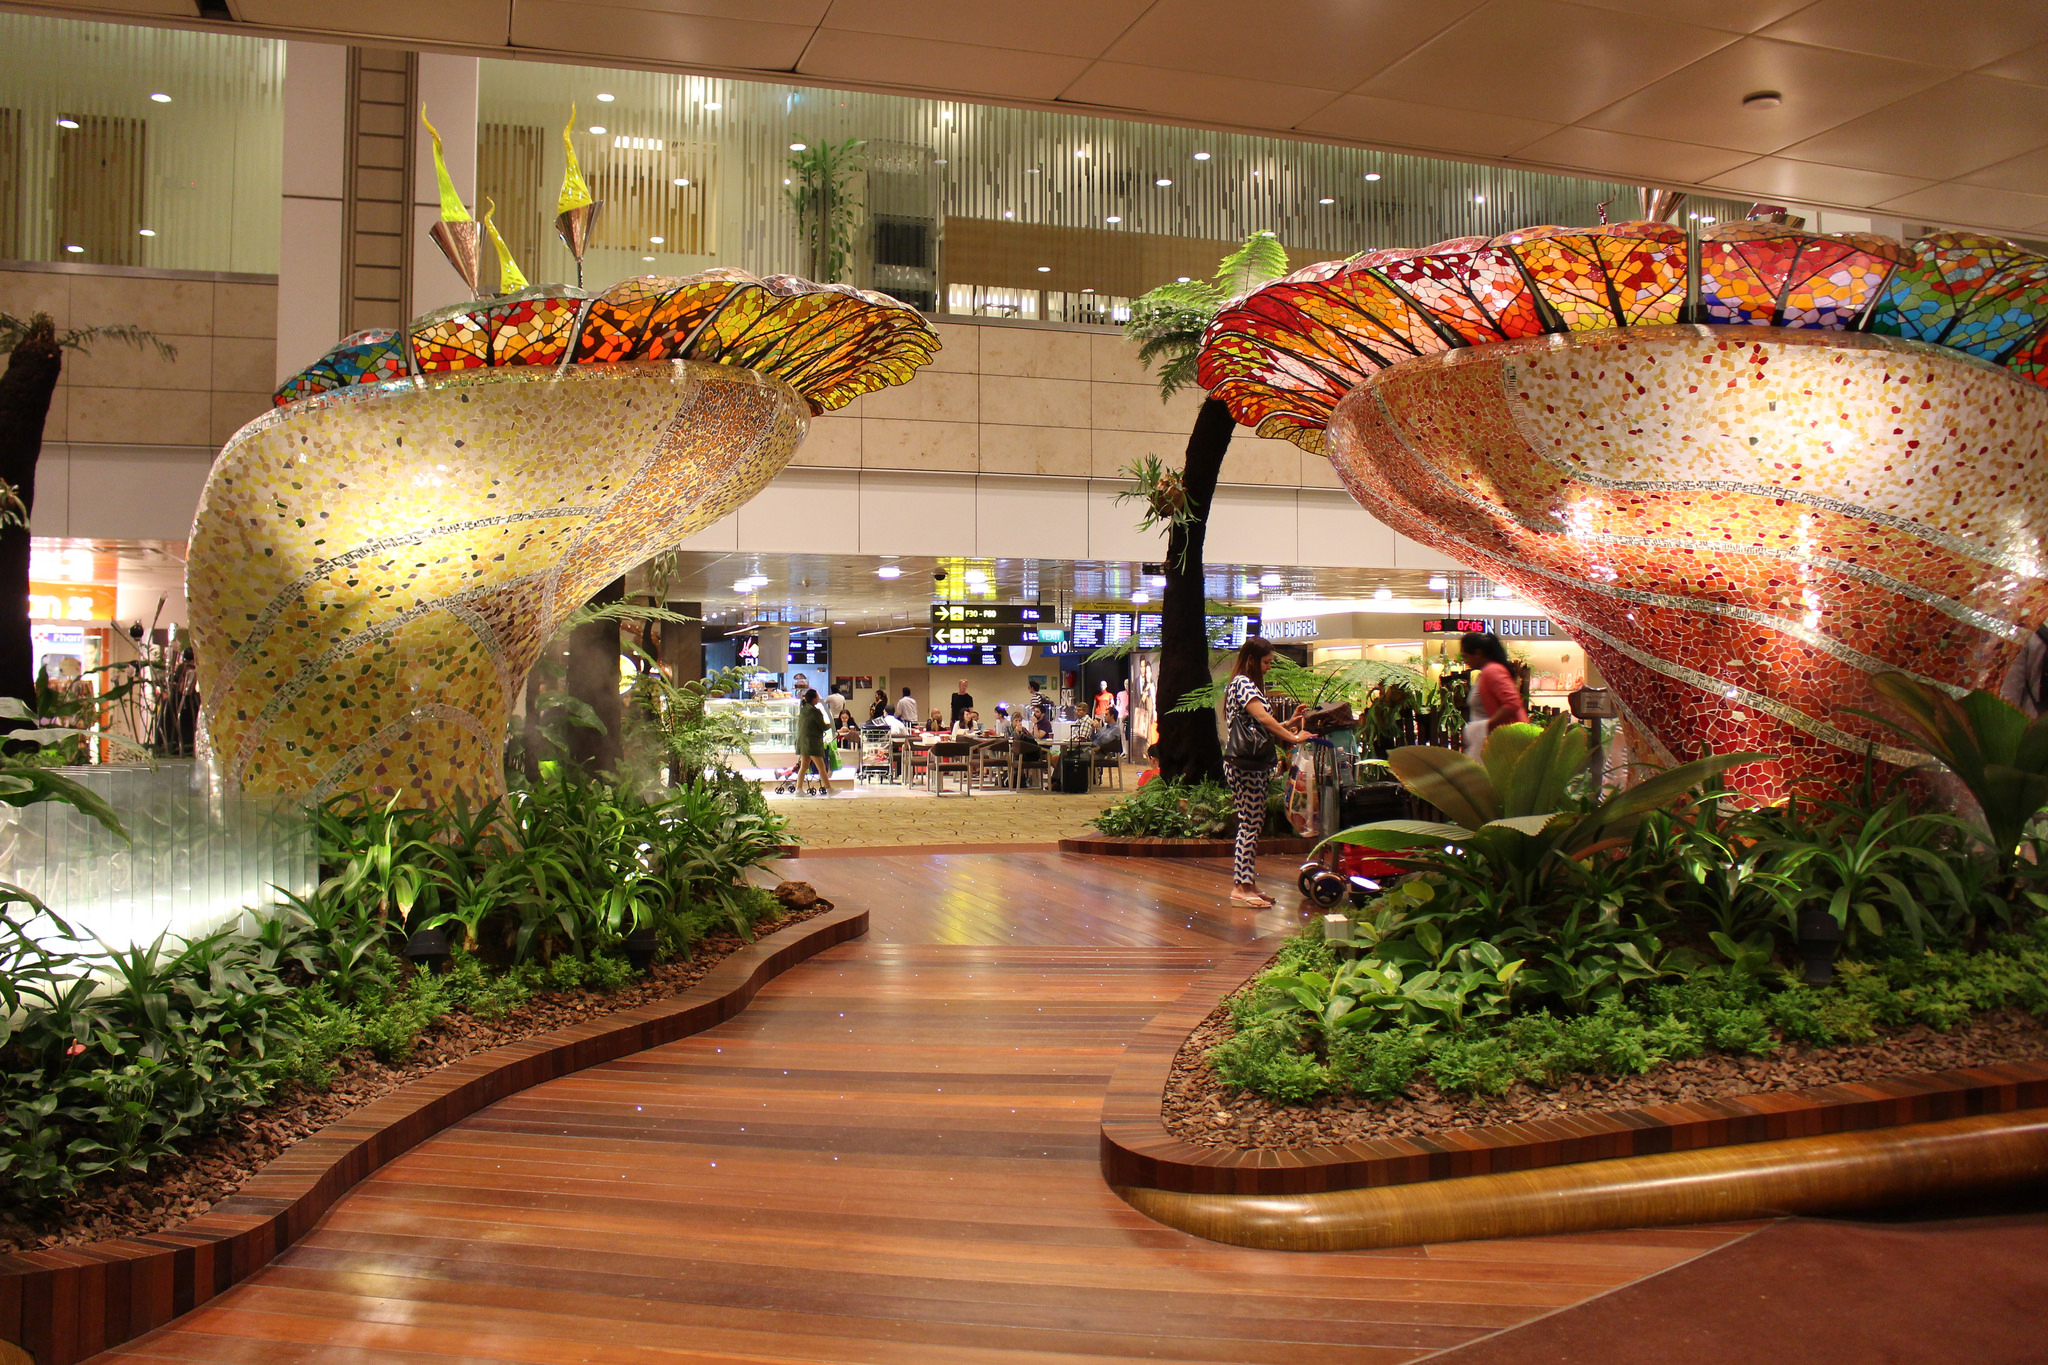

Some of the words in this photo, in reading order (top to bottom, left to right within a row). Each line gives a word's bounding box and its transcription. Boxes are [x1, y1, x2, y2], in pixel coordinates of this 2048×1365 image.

[965, 610, 978, 618] F30
[1260, 622, 1283, 638] RAUN
[1457, 620, 1484, 632] 07:06
[965, 628, 978, 636] D40
[983, 628, 995, 636] D41
[1045, 631, 1060, 641] EXIT
